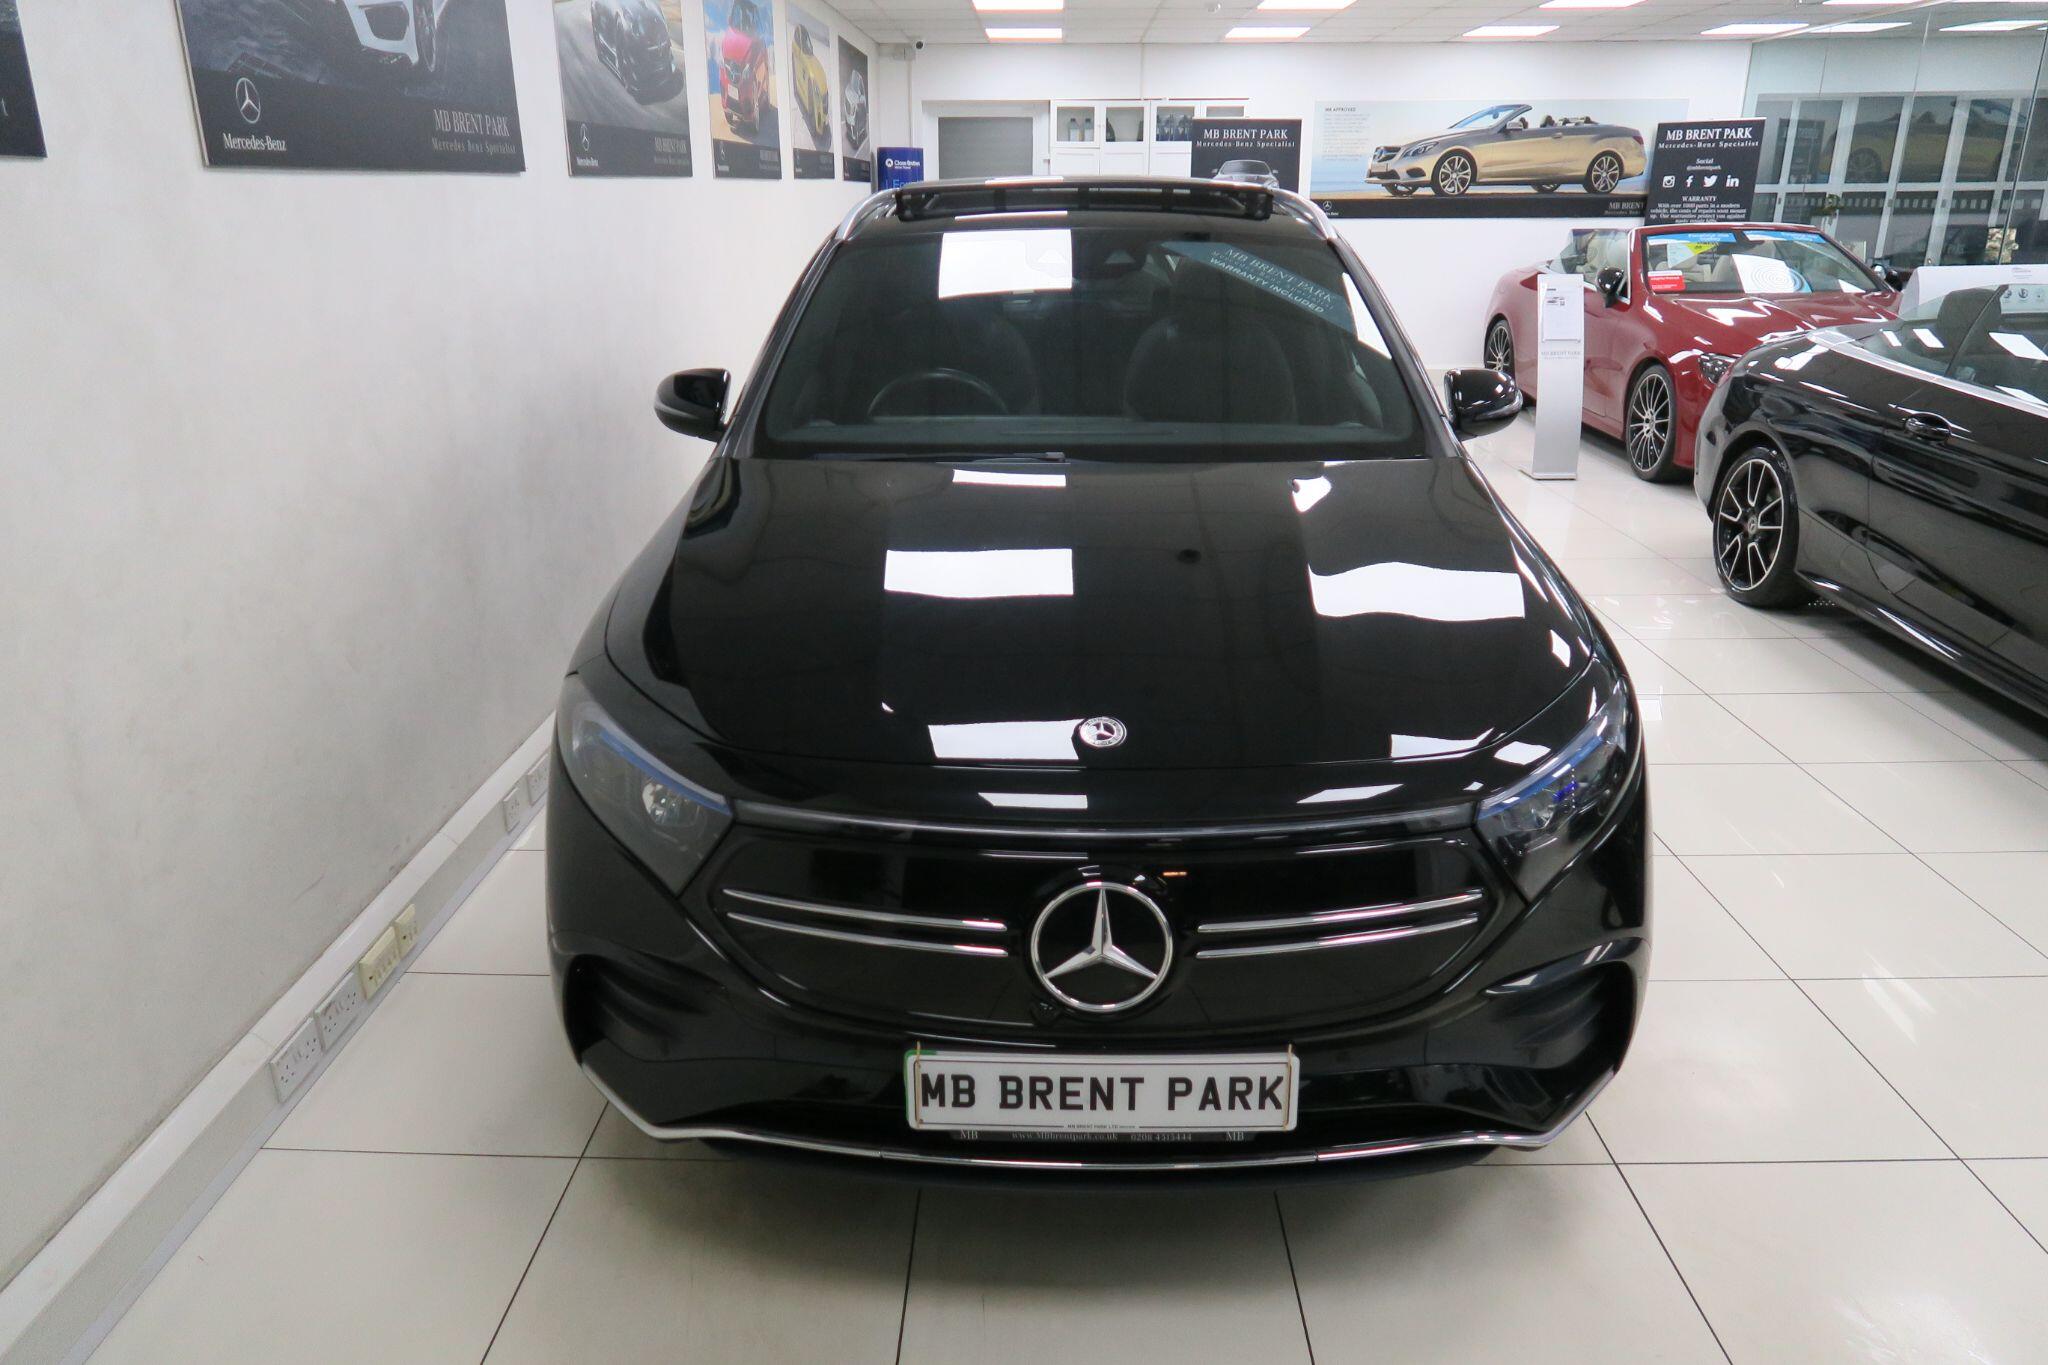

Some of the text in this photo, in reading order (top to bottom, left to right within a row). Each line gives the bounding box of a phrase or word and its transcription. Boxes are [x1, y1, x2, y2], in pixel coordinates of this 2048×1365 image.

[434, 109, 510, 136] MB BRENT PARK
[222, 132, 286, 151] Mercedes-Benz
[1203, 129, 1288, 139] MB BRENT PARK
[1666, 127, 1753, 140] MB BRENT PARK
[1196, 140, 1295, 149] Mercedes-Benz Specialist
[1719, 140, 1759, 148] Specialist
[1226, 249, 1332, 303] MB BRENT PARK
[1210, 257, 1325, 313] WARRANTY INCLUDED
[921, 1073, 1284, 1111] MB BRENT PARK
[960, 1130, 978, 1140] MB
[1226, 1131, 1245, 1141] MB
